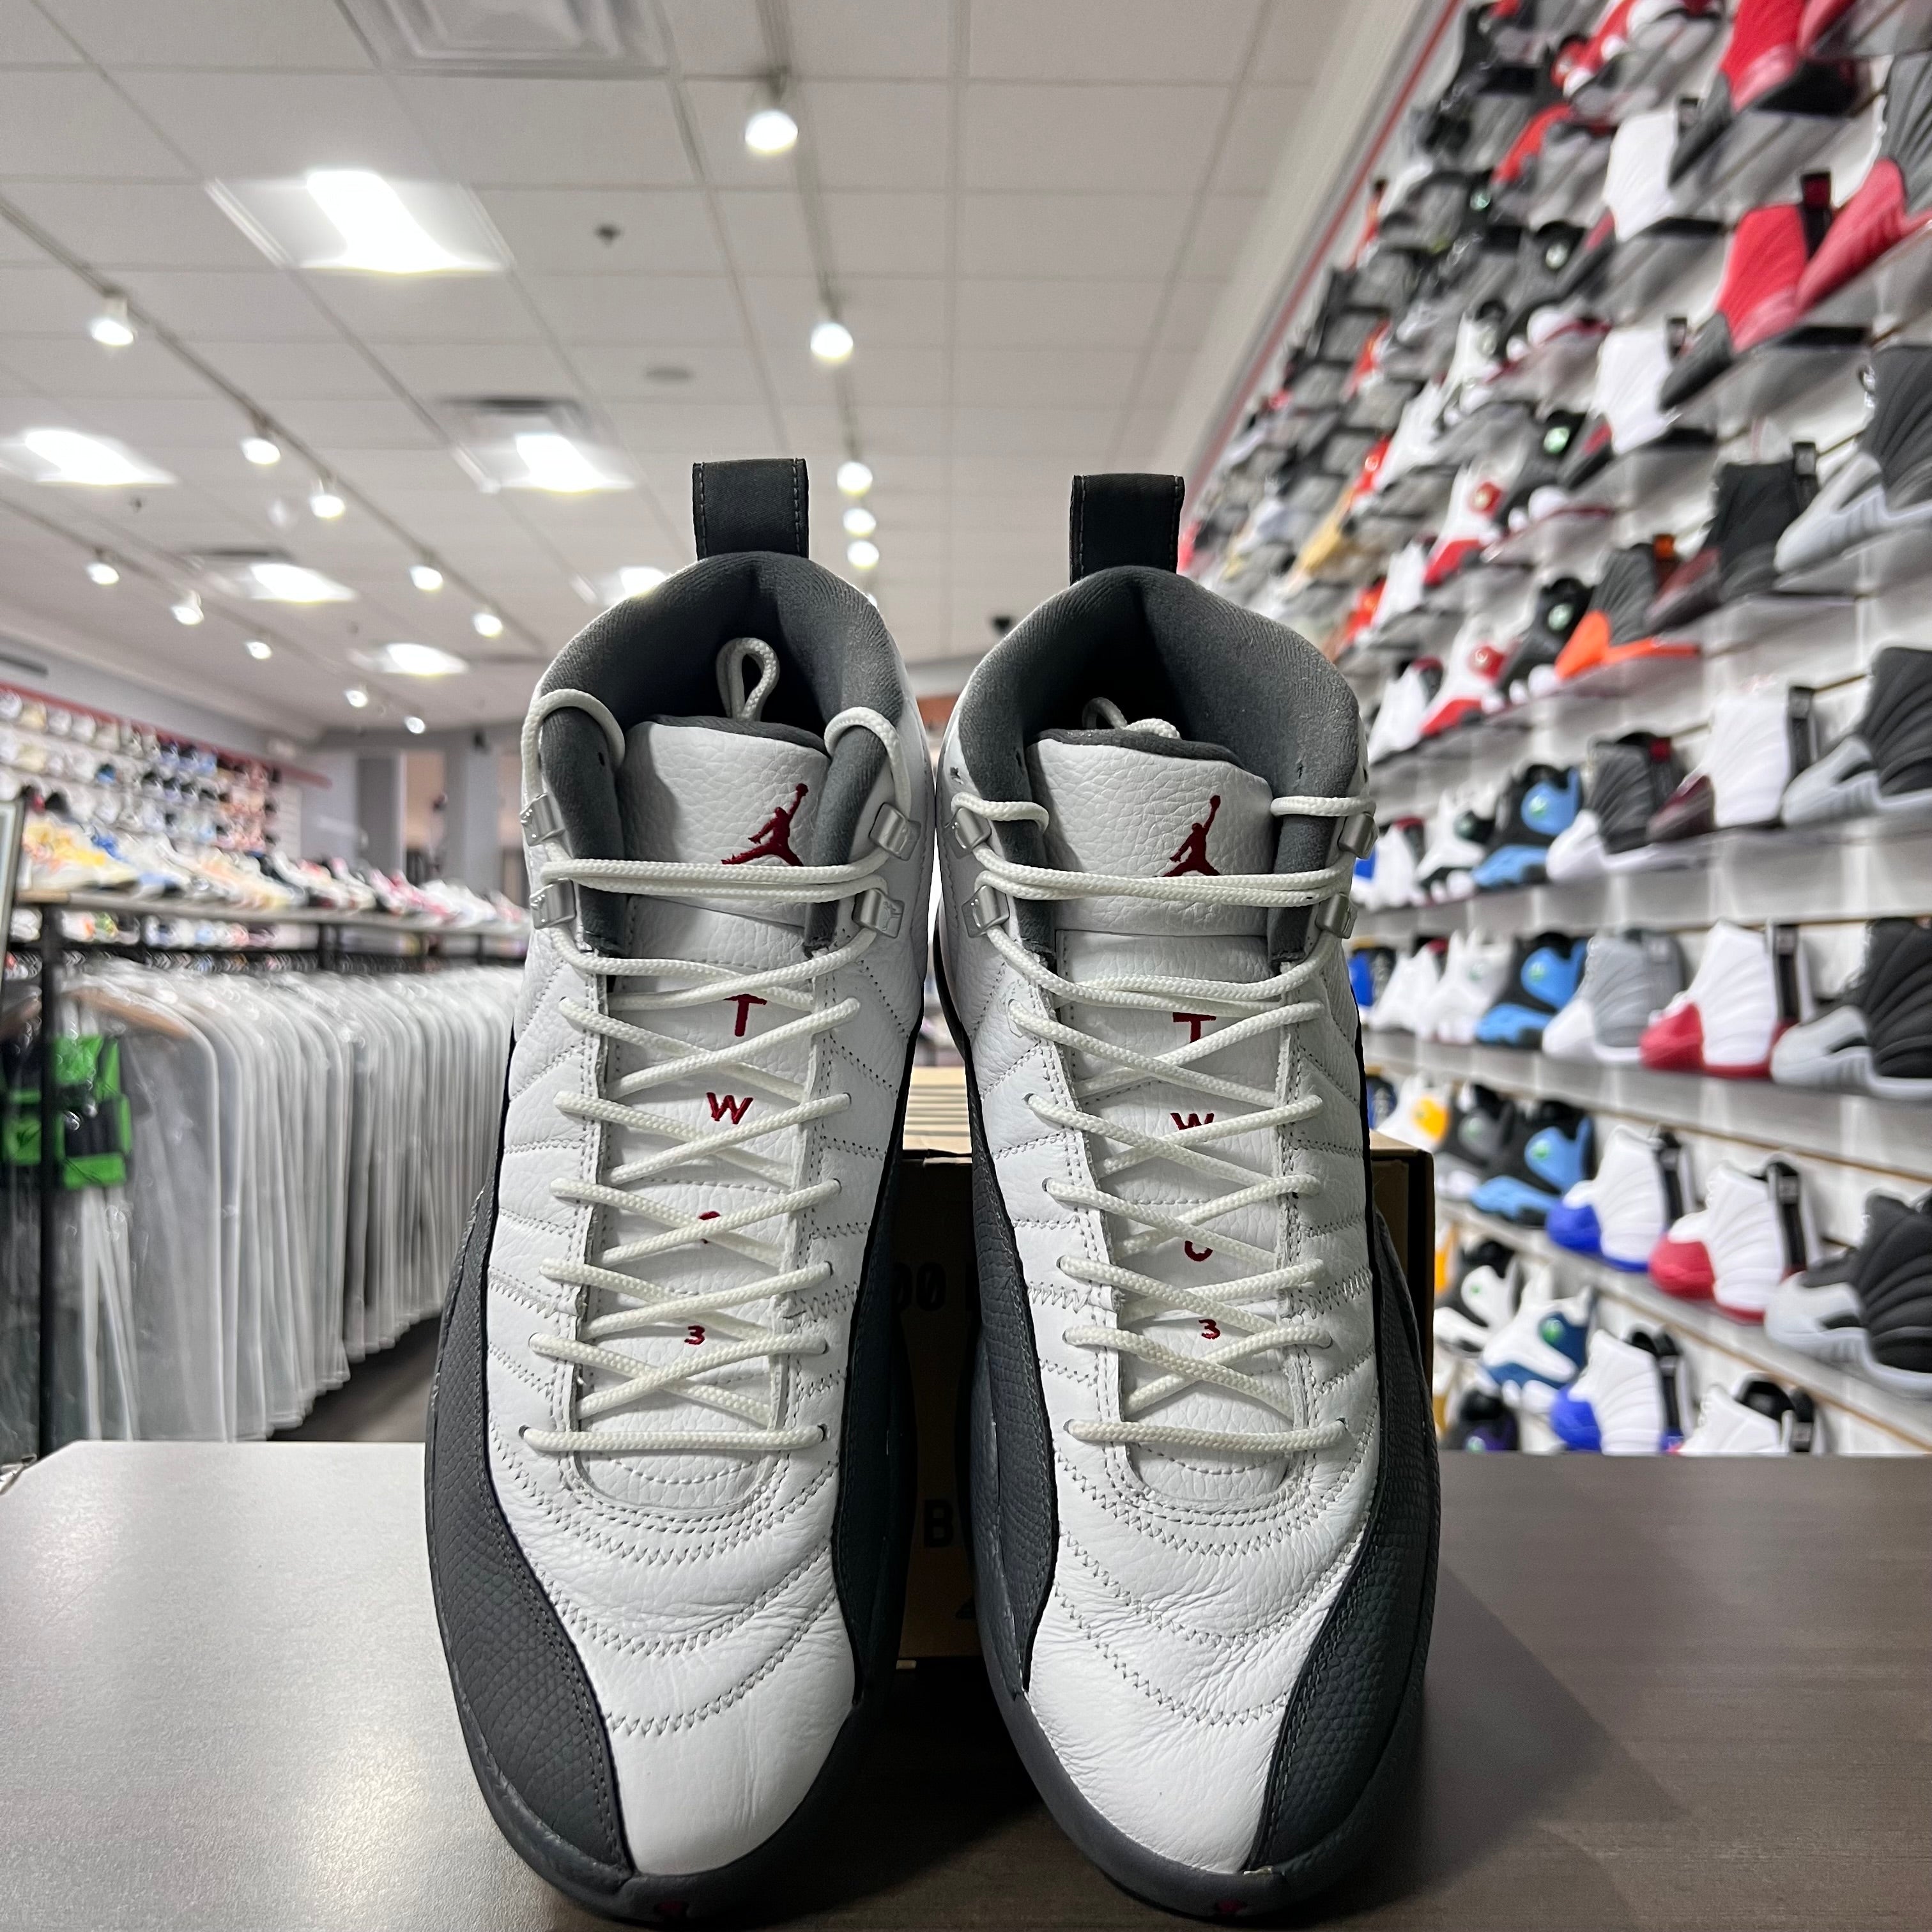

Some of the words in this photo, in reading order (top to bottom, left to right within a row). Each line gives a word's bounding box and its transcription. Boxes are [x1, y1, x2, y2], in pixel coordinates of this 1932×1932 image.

[723, 993, 767, 1037] T
[1172, 1012, 1216, 1043] T
[707, 1092, 754, 1124] W
[684, 1325, 705, 1345] 3
[1199, 1319, 1220, 1340] 3
